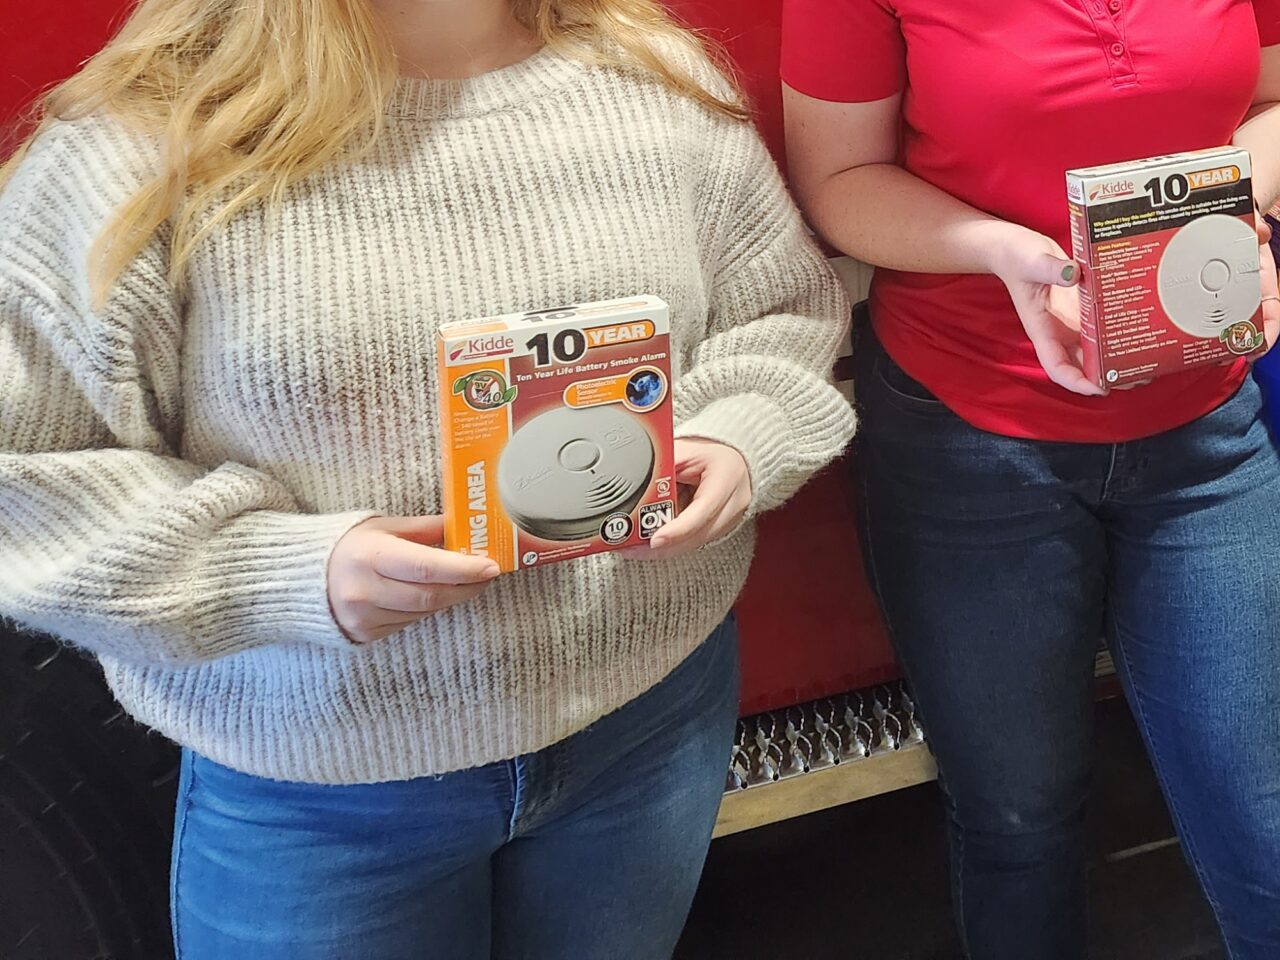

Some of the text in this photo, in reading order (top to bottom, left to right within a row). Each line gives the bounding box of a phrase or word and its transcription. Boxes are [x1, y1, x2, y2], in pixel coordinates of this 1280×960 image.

[1102, 181, 1134, 194] Kidde
[1144, 169, 1234, 208] 10 YEAR
[468, 334, 514, 352] Kidde
[526, 324, 648, 366] 10 YEAR
[516, 352, 666, 382] Ten Year Life Battery Smoke Alarm
[576, 380, 617, 390] Photoelectric
[467, 460, 488, 511] AREA
[640, 503, 671, 513] ALWAYS
[608, 521, 624, 532] 10
